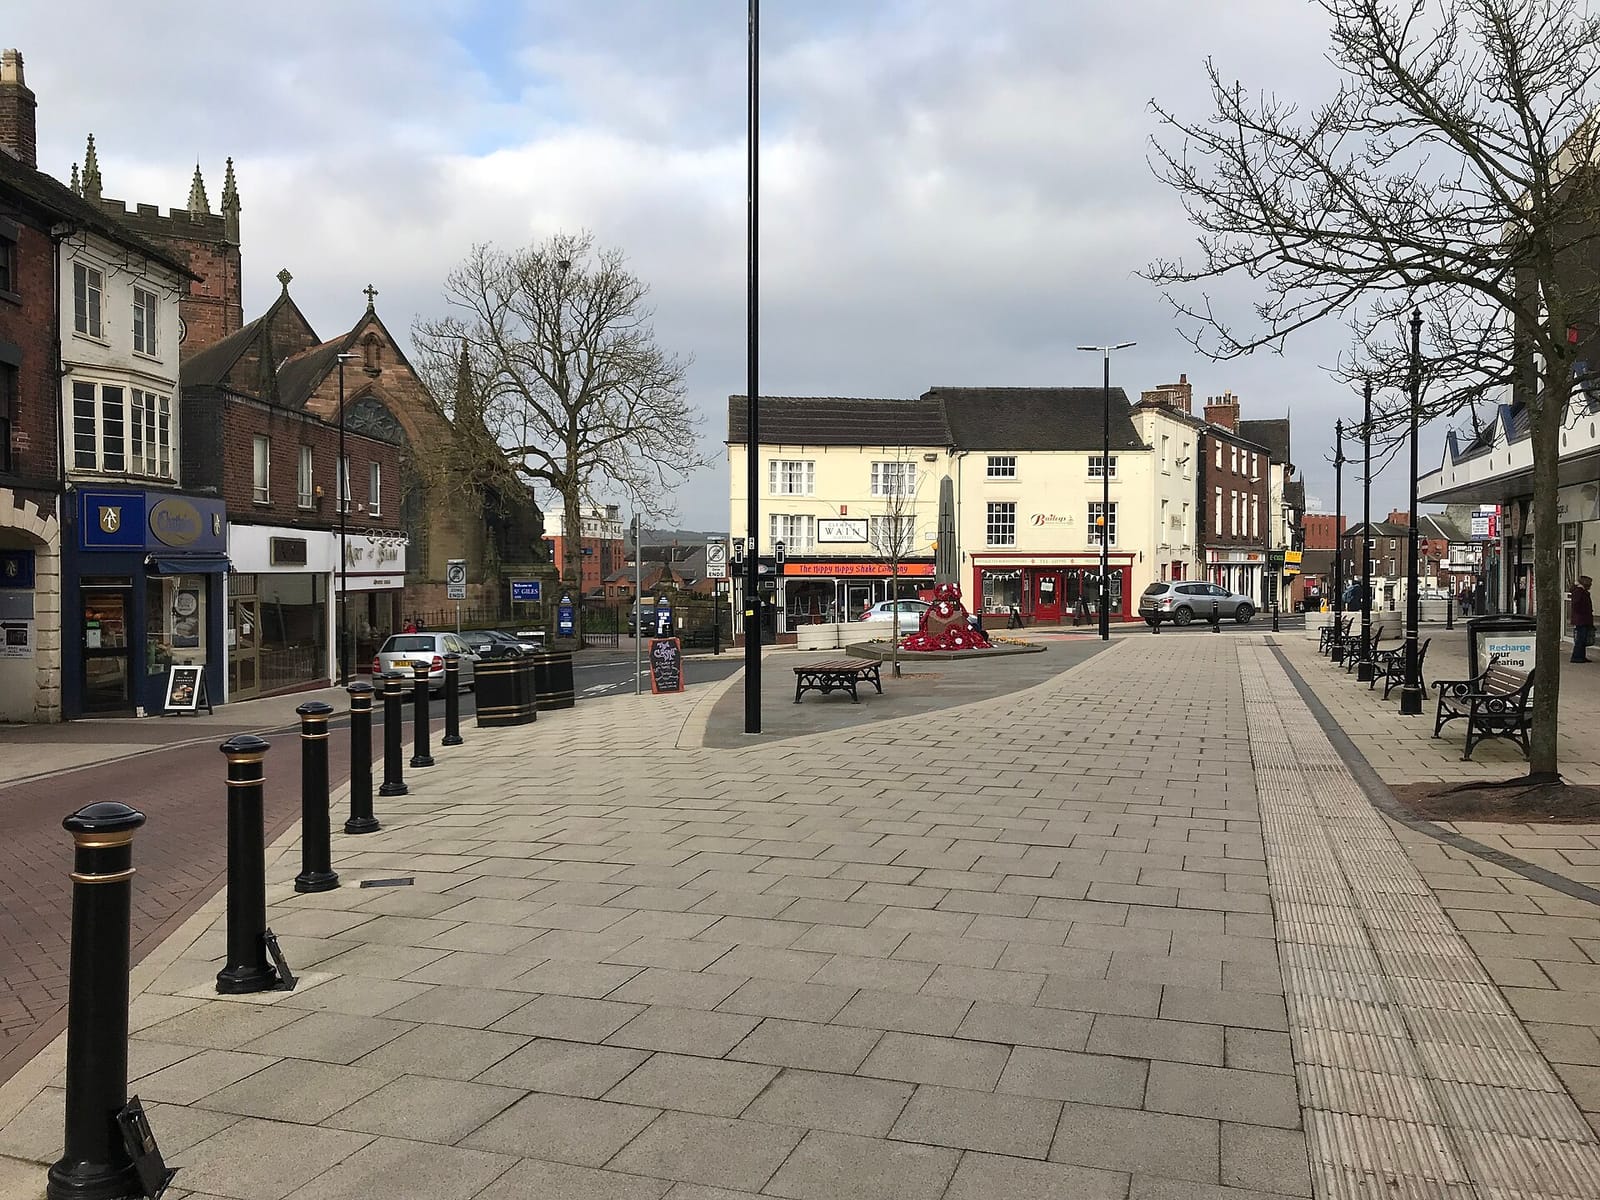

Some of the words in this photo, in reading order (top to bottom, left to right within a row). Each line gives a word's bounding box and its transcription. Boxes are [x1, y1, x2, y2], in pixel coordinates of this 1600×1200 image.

[800, 565, 812, 573] The
[855, 565, 876, 573] Shake
[877, 565, 908, 574] Comany
[1489, 644, 1531, 652] Recharge
[1496, 659, 1524, 667] earing
